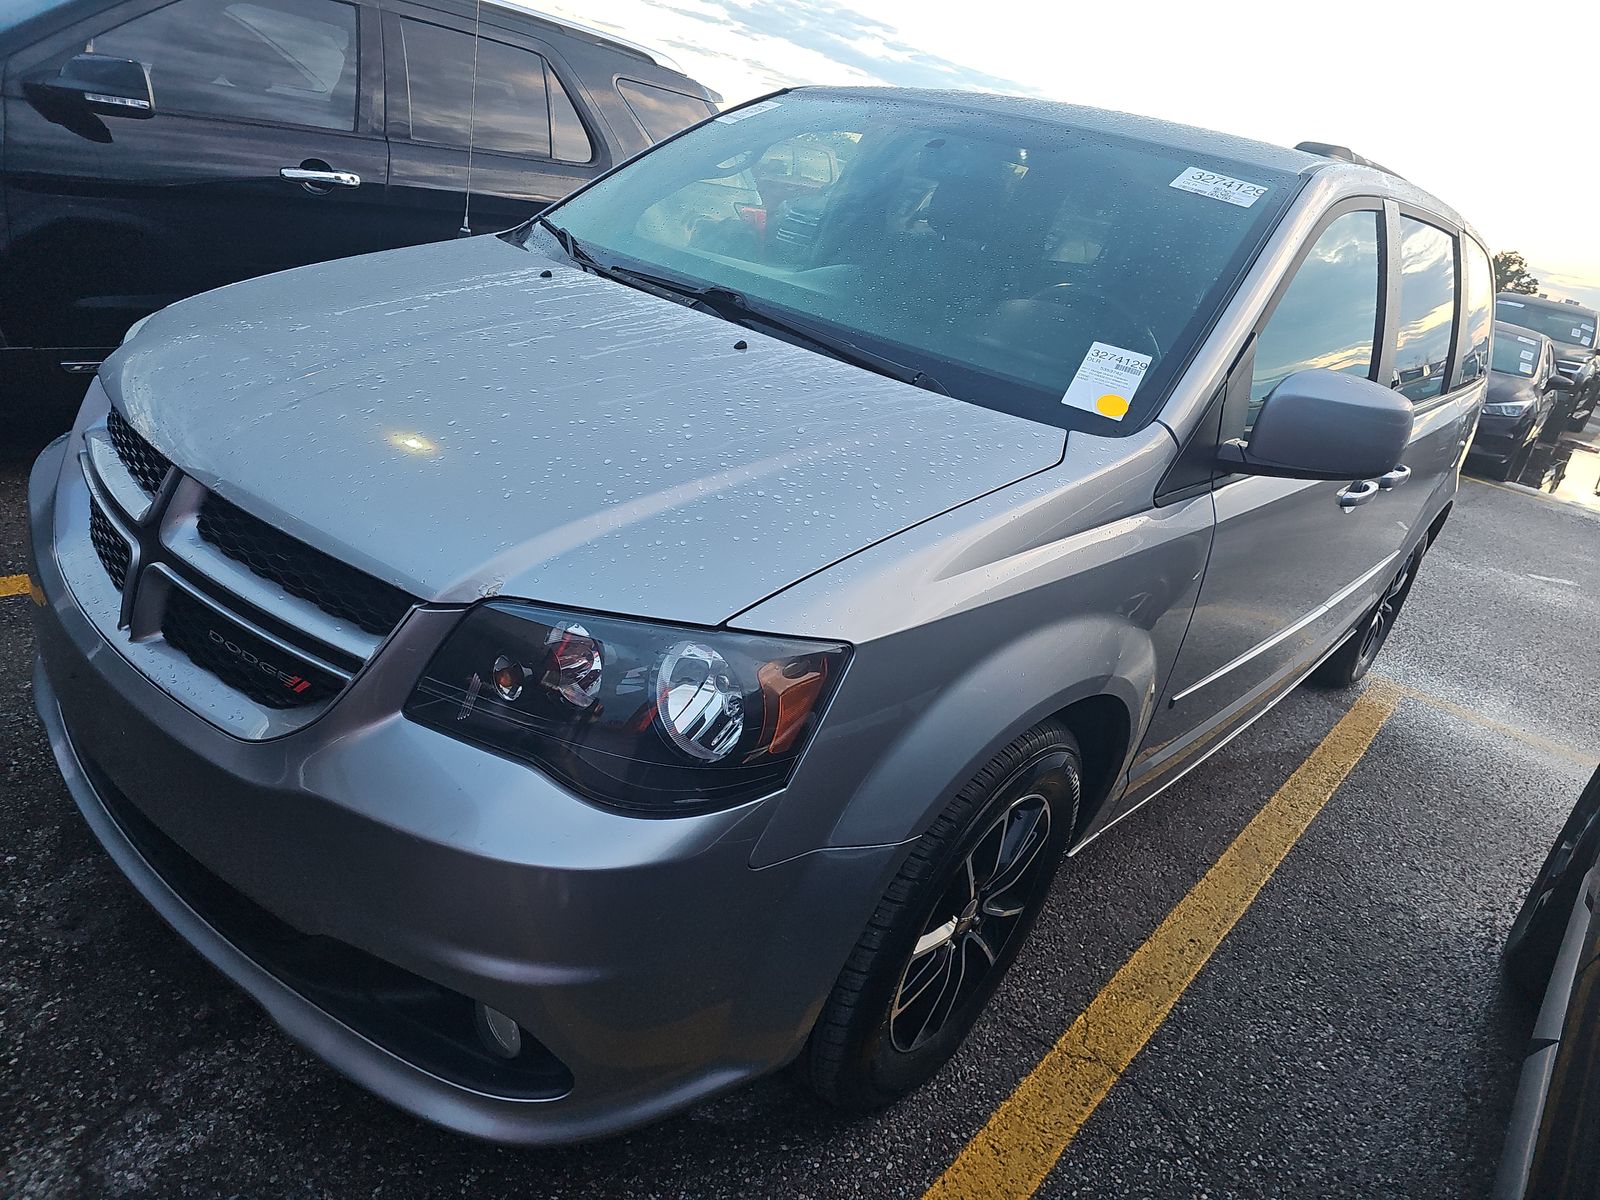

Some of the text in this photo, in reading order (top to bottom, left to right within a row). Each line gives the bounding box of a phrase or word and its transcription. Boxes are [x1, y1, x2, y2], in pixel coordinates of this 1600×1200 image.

[1191, 171, 1267, 197] 3274129
[1086, 356, 1102, 365] DLR
[1091, 348, 1148, 371] 3274129
[208, 629, 296, 687] DODGE
